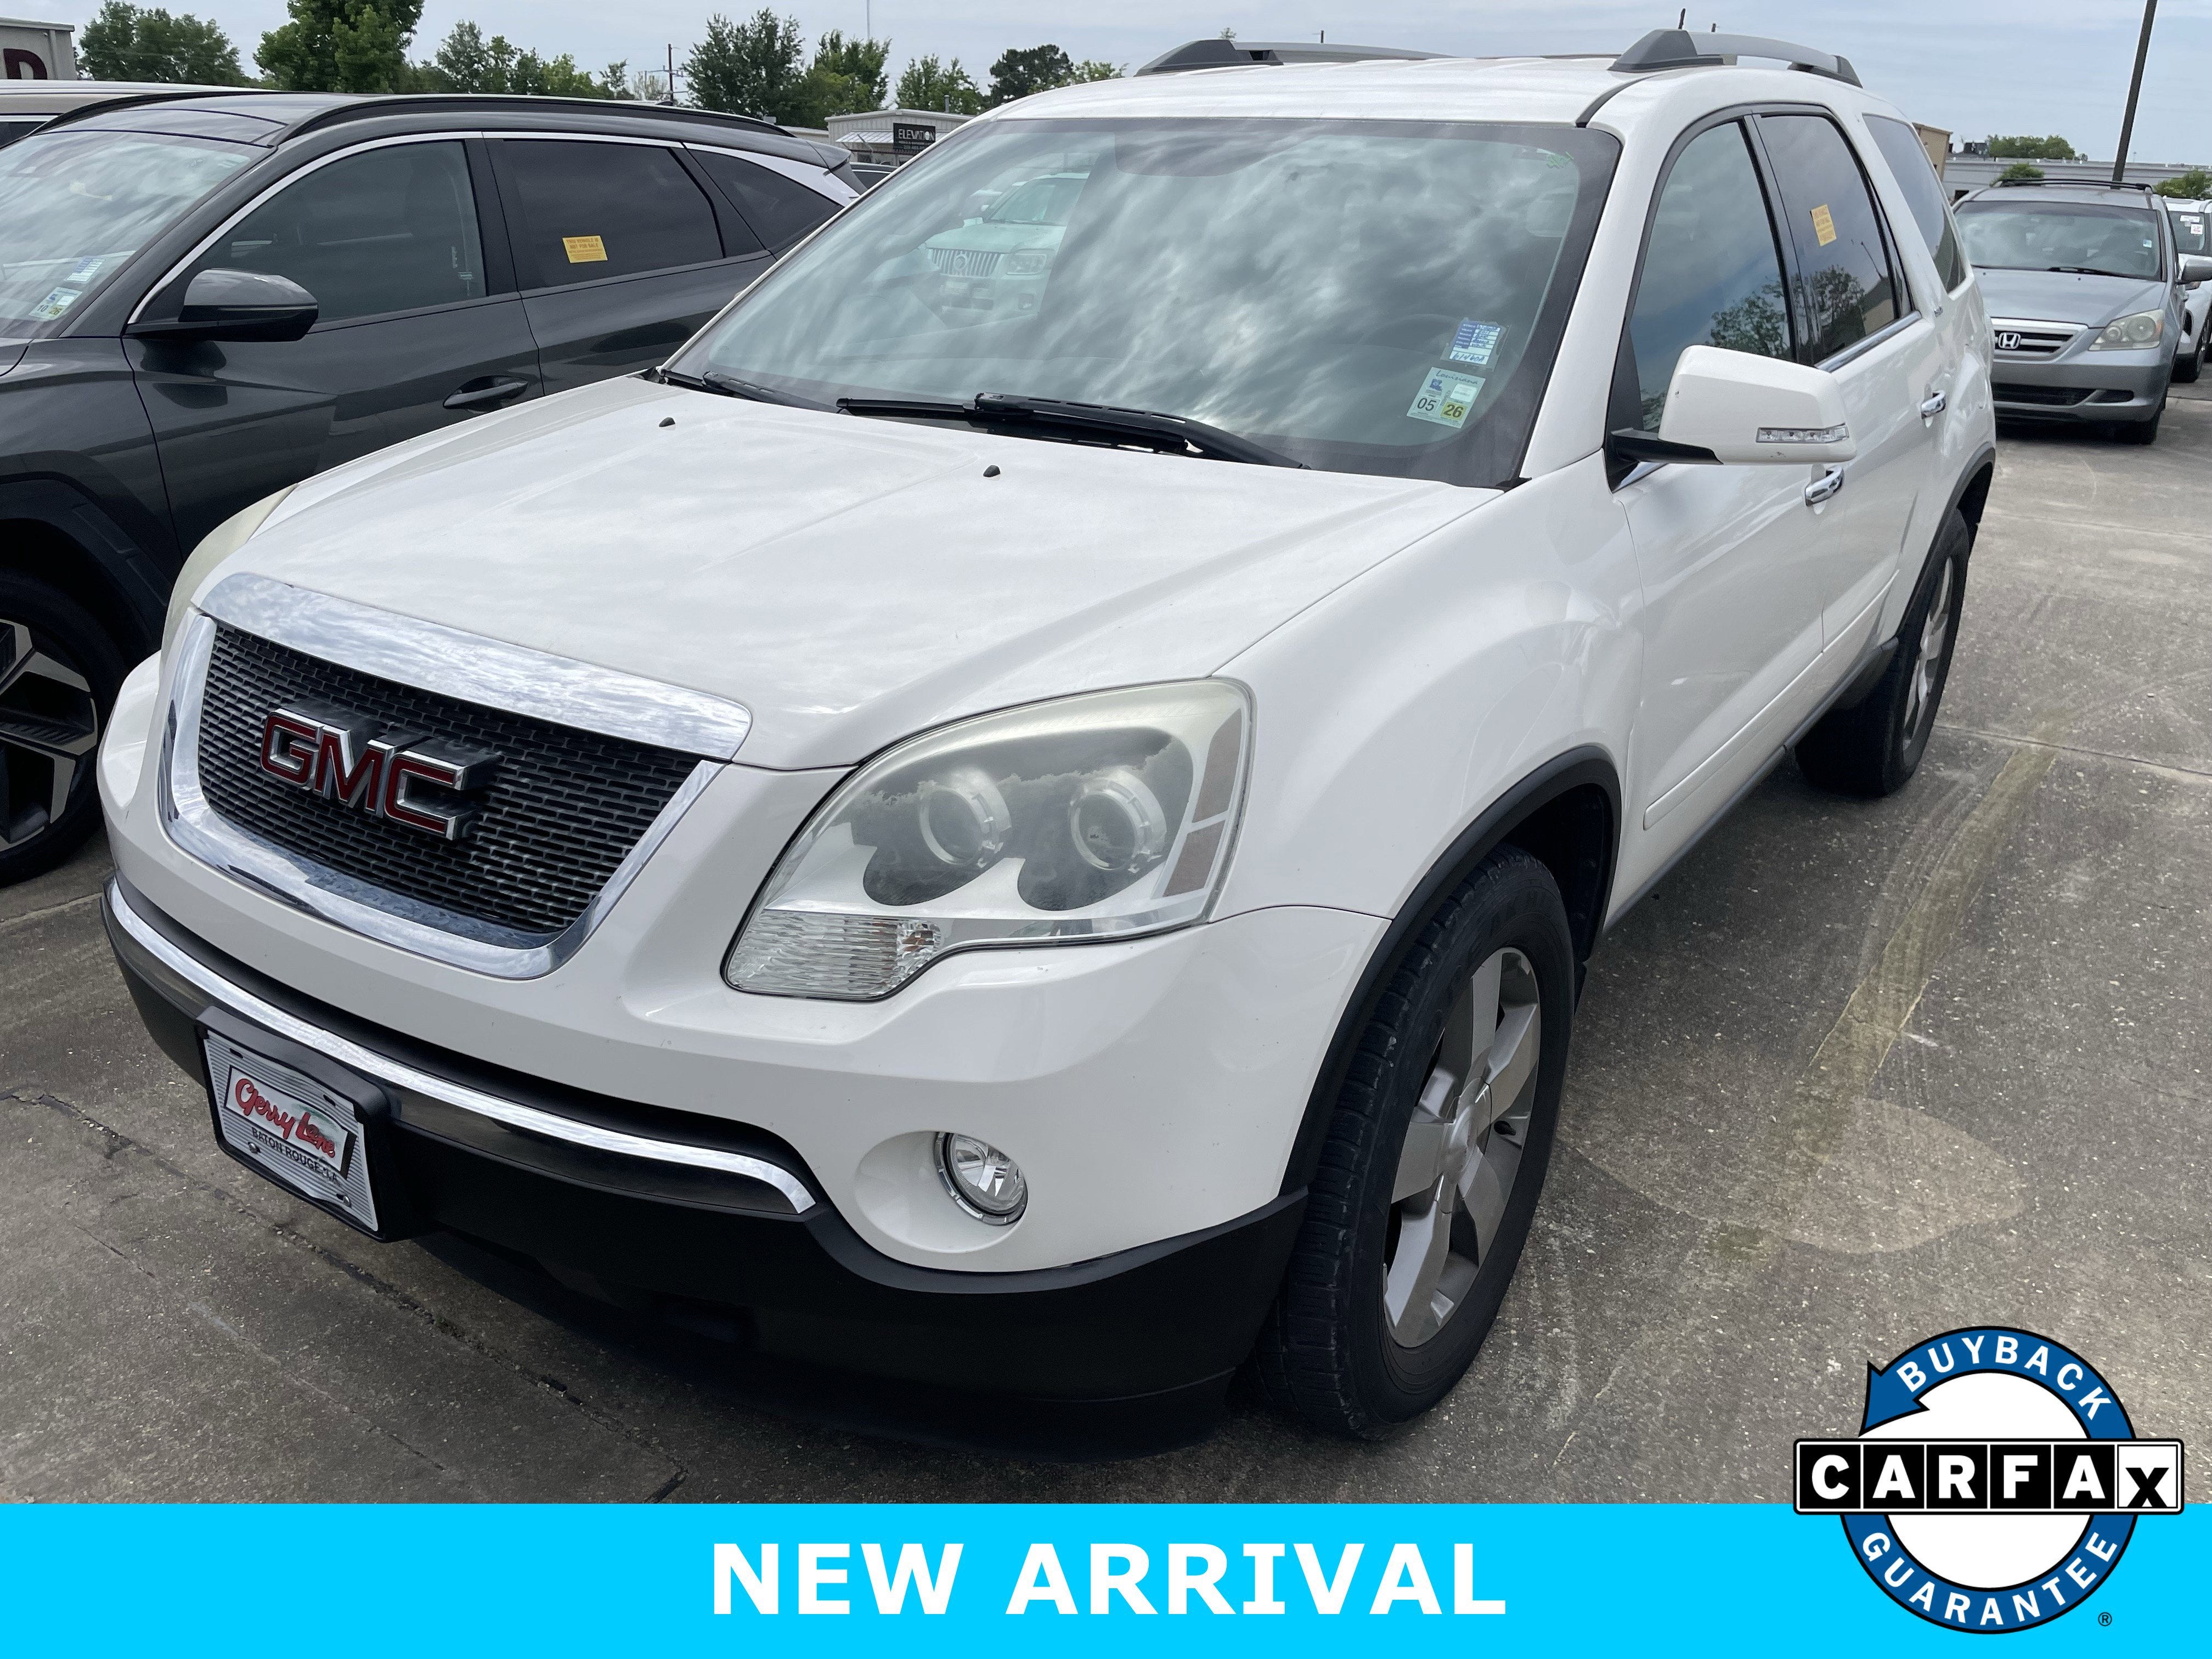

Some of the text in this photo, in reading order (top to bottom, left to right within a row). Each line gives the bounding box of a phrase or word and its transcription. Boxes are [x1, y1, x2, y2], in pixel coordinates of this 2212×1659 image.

[1435, 370, 1479, 385] Louisiana
[1417, 398, 1437, 411] 05
[1443, 404, 1464, 418] 26
[261, 708, 468, 841] GMC
[235, 1078, 296, 1139] Gerry
[251, 1126, 283, 1153] BATON
